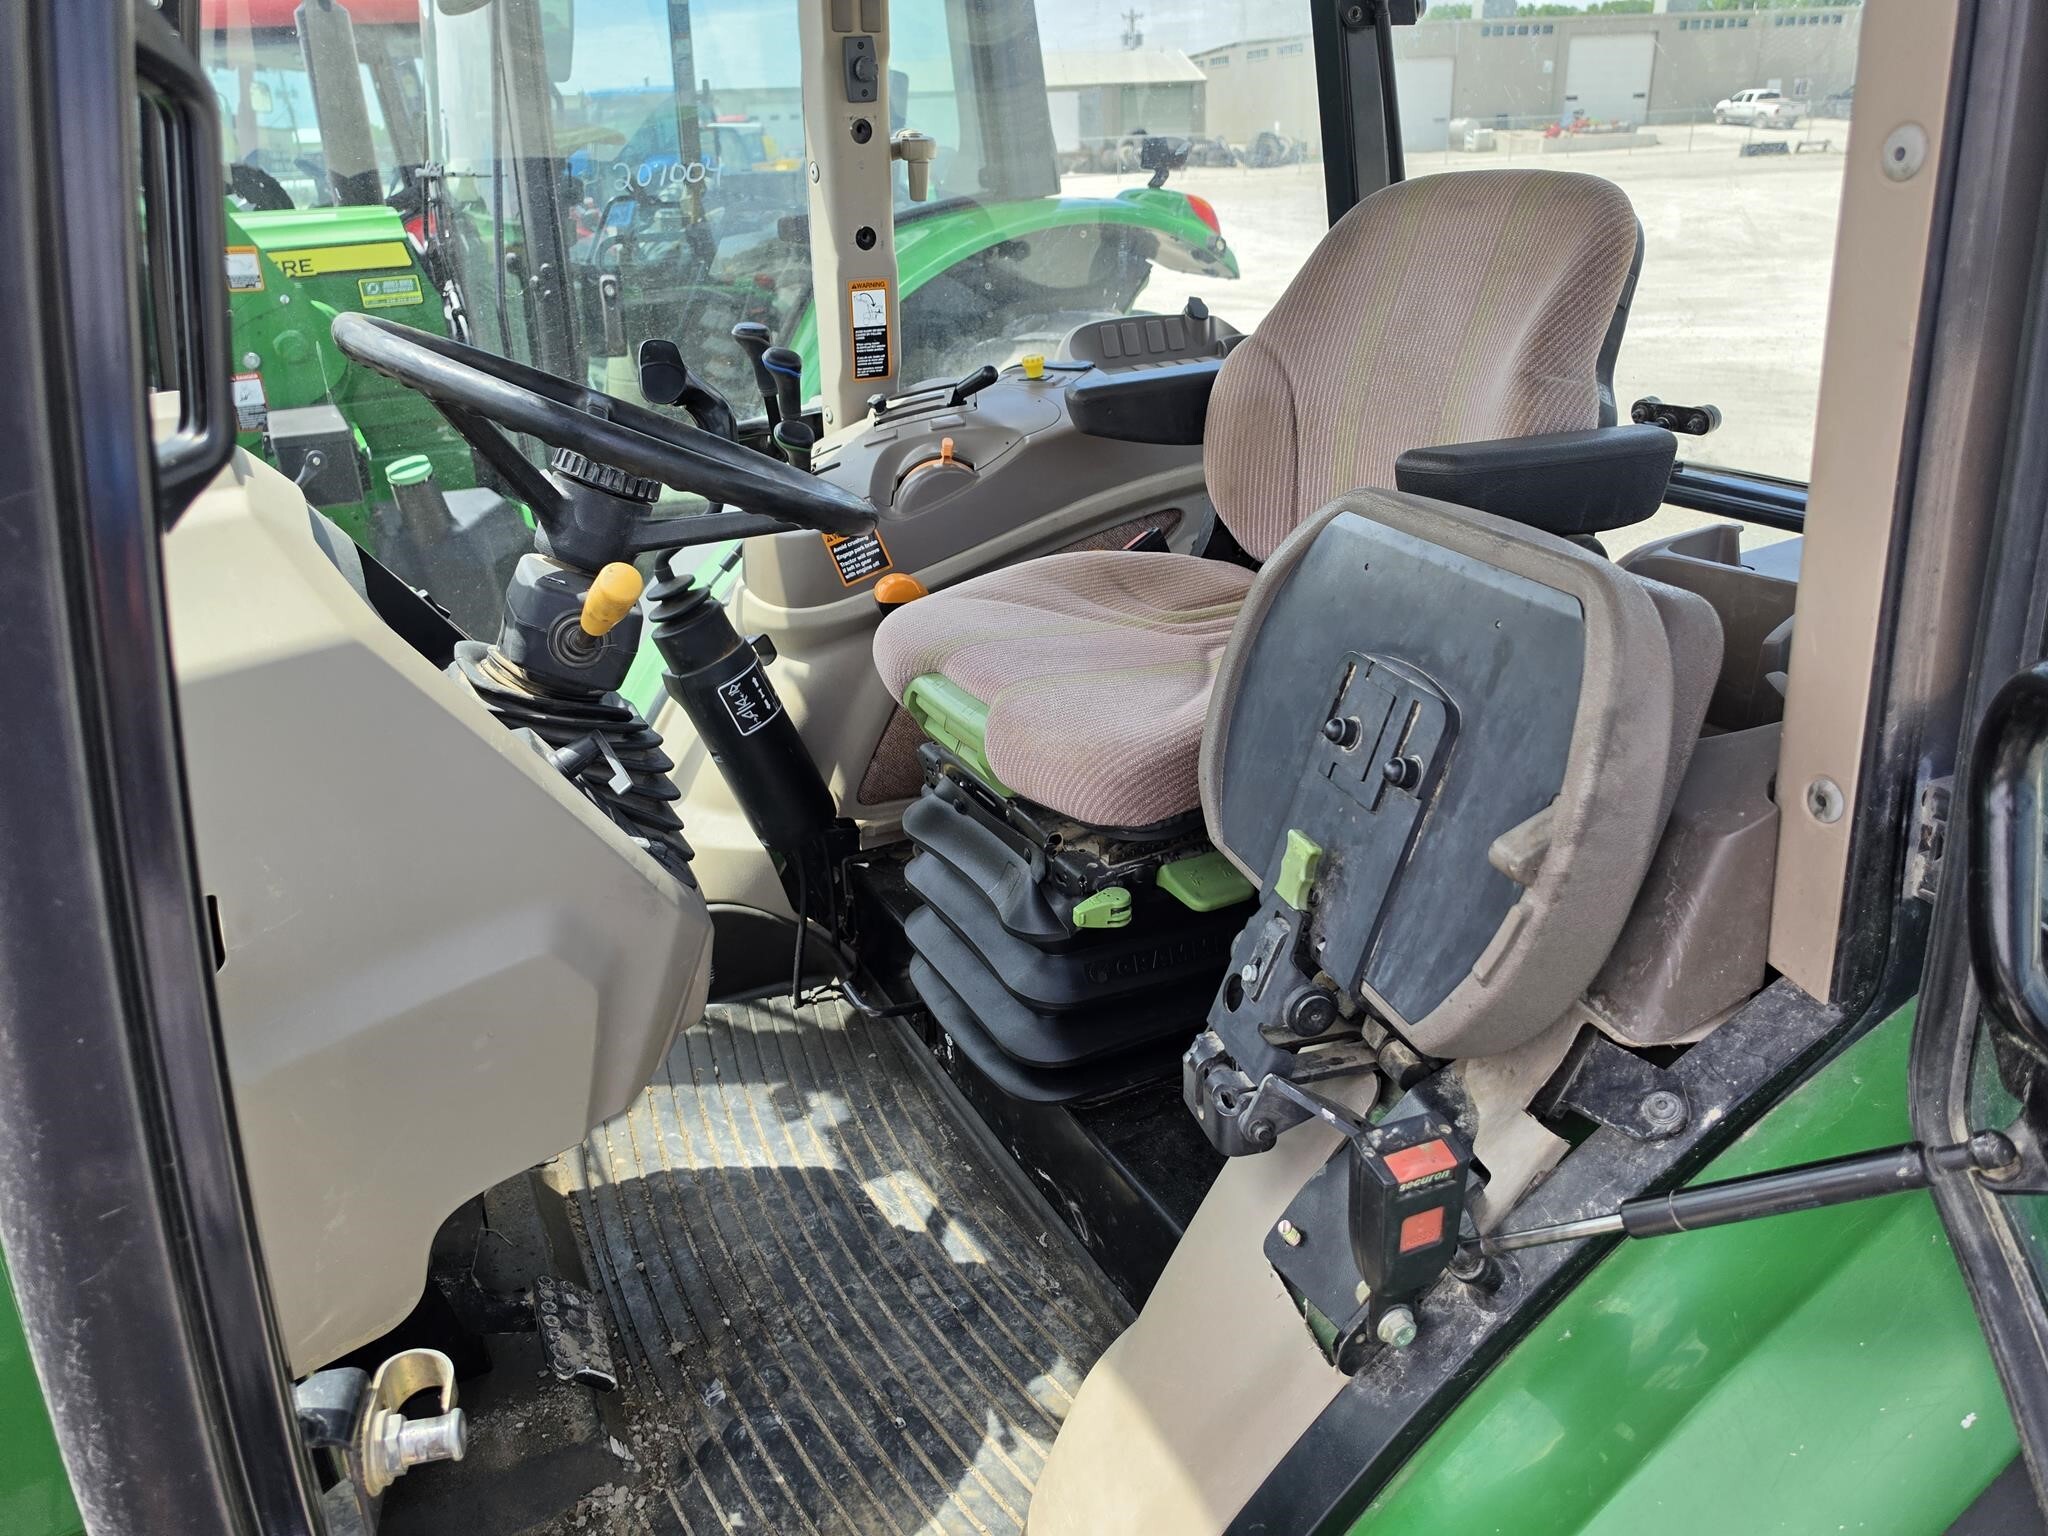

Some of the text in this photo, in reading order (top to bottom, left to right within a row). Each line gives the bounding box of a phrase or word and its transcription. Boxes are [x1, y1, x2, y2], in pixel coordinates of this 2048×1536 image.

[275, 259, 315, 275] RE
[834, 544, 847, 553] Avoid
[848, 536, 869, 547] crushing
[836, 550, 854, 560] Engage
[854, 546, 865, 554] park
[840, 558, 856, 567] Tractor
[866, 548, 880, 556] move
[1399, 1169, 1451, 1192] securon
